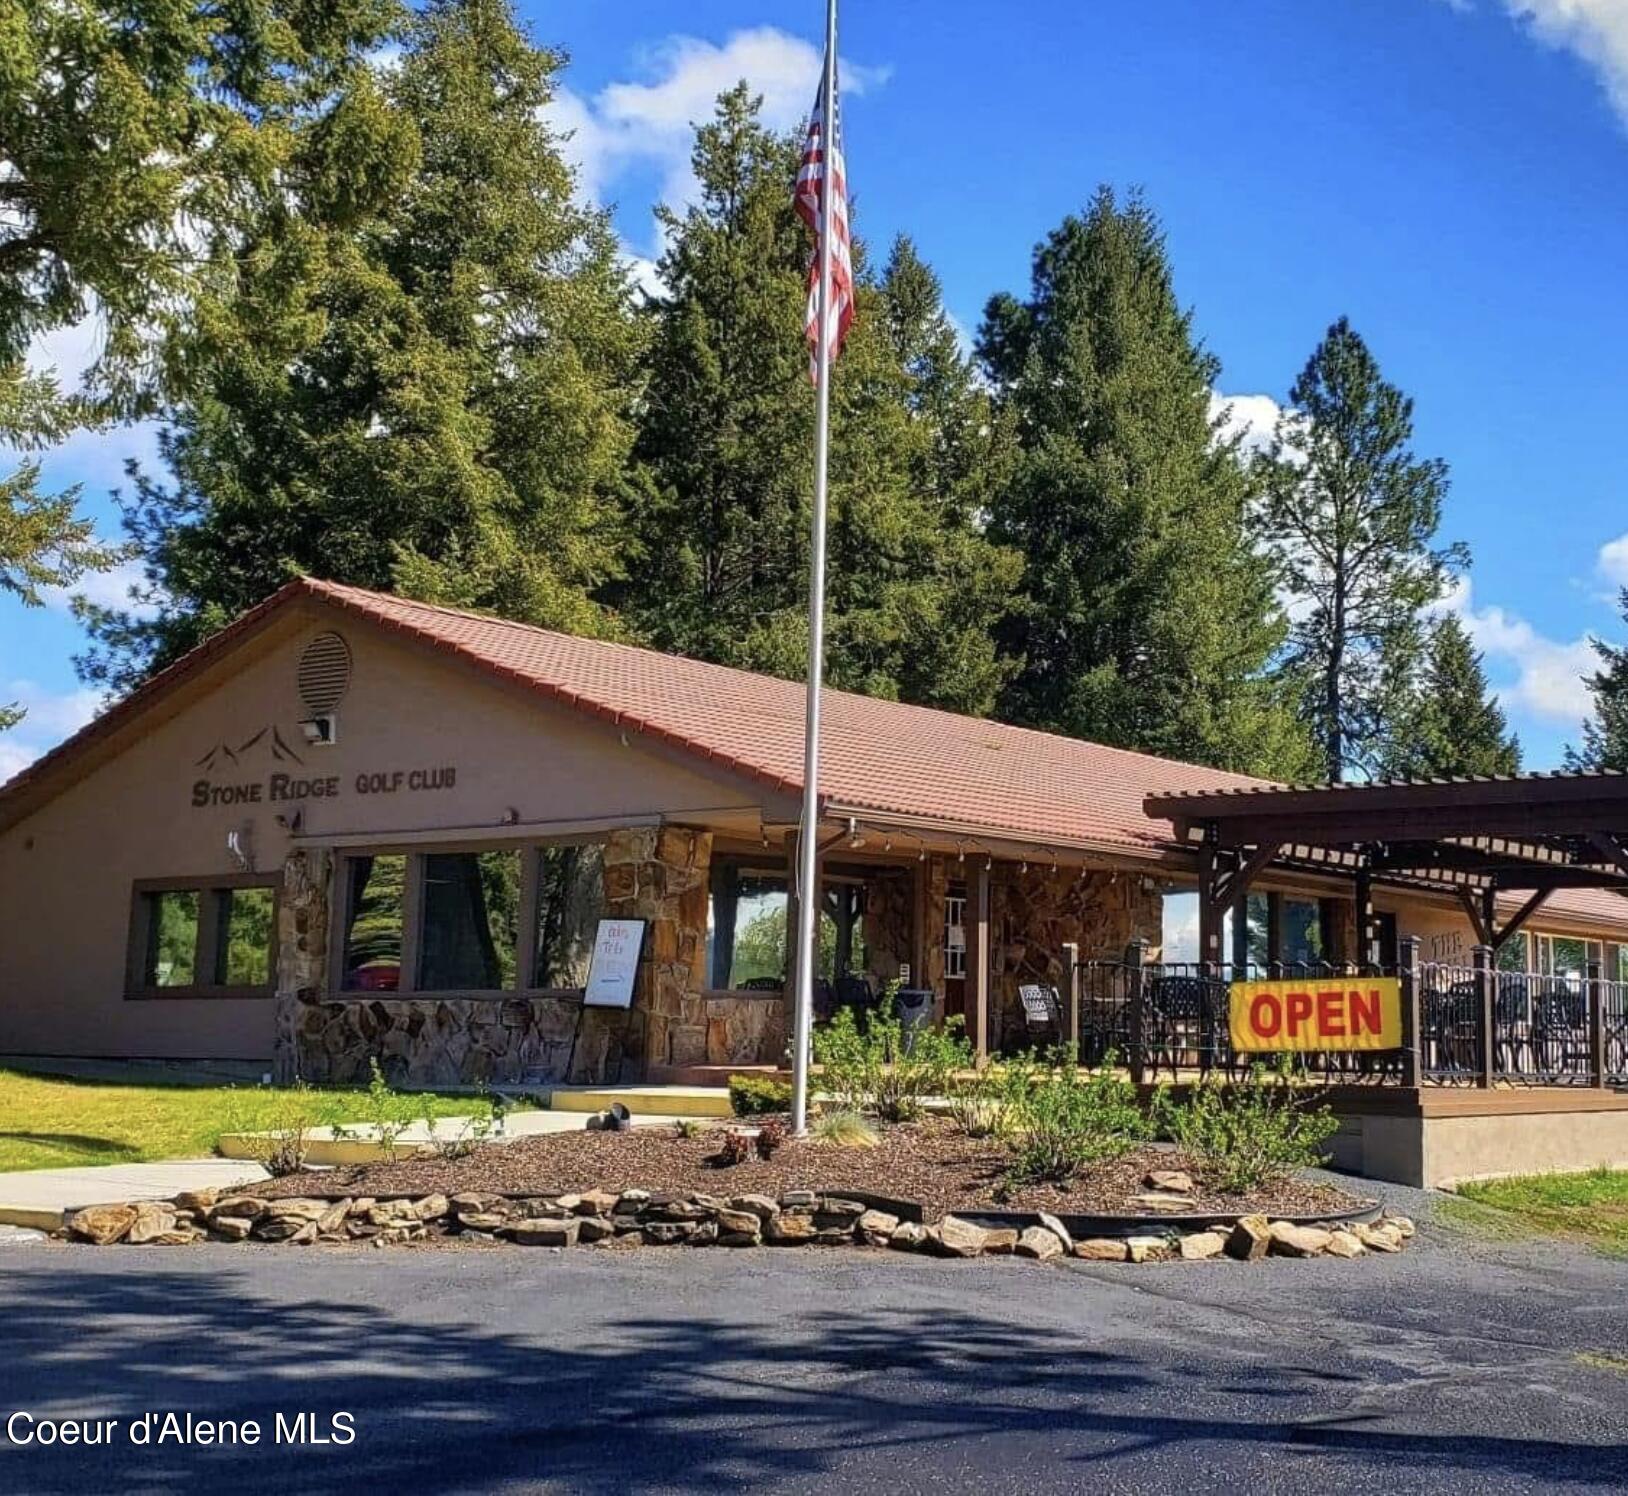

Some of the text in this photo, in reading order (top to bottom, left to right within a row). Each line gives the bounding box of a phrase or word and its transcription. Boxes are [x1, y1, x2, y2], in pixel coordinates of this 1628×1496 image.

[192, 767, 456, 807] STONE RIDGE GOLF CLUB
[1250, 990, 1382, 1038] OPEN
